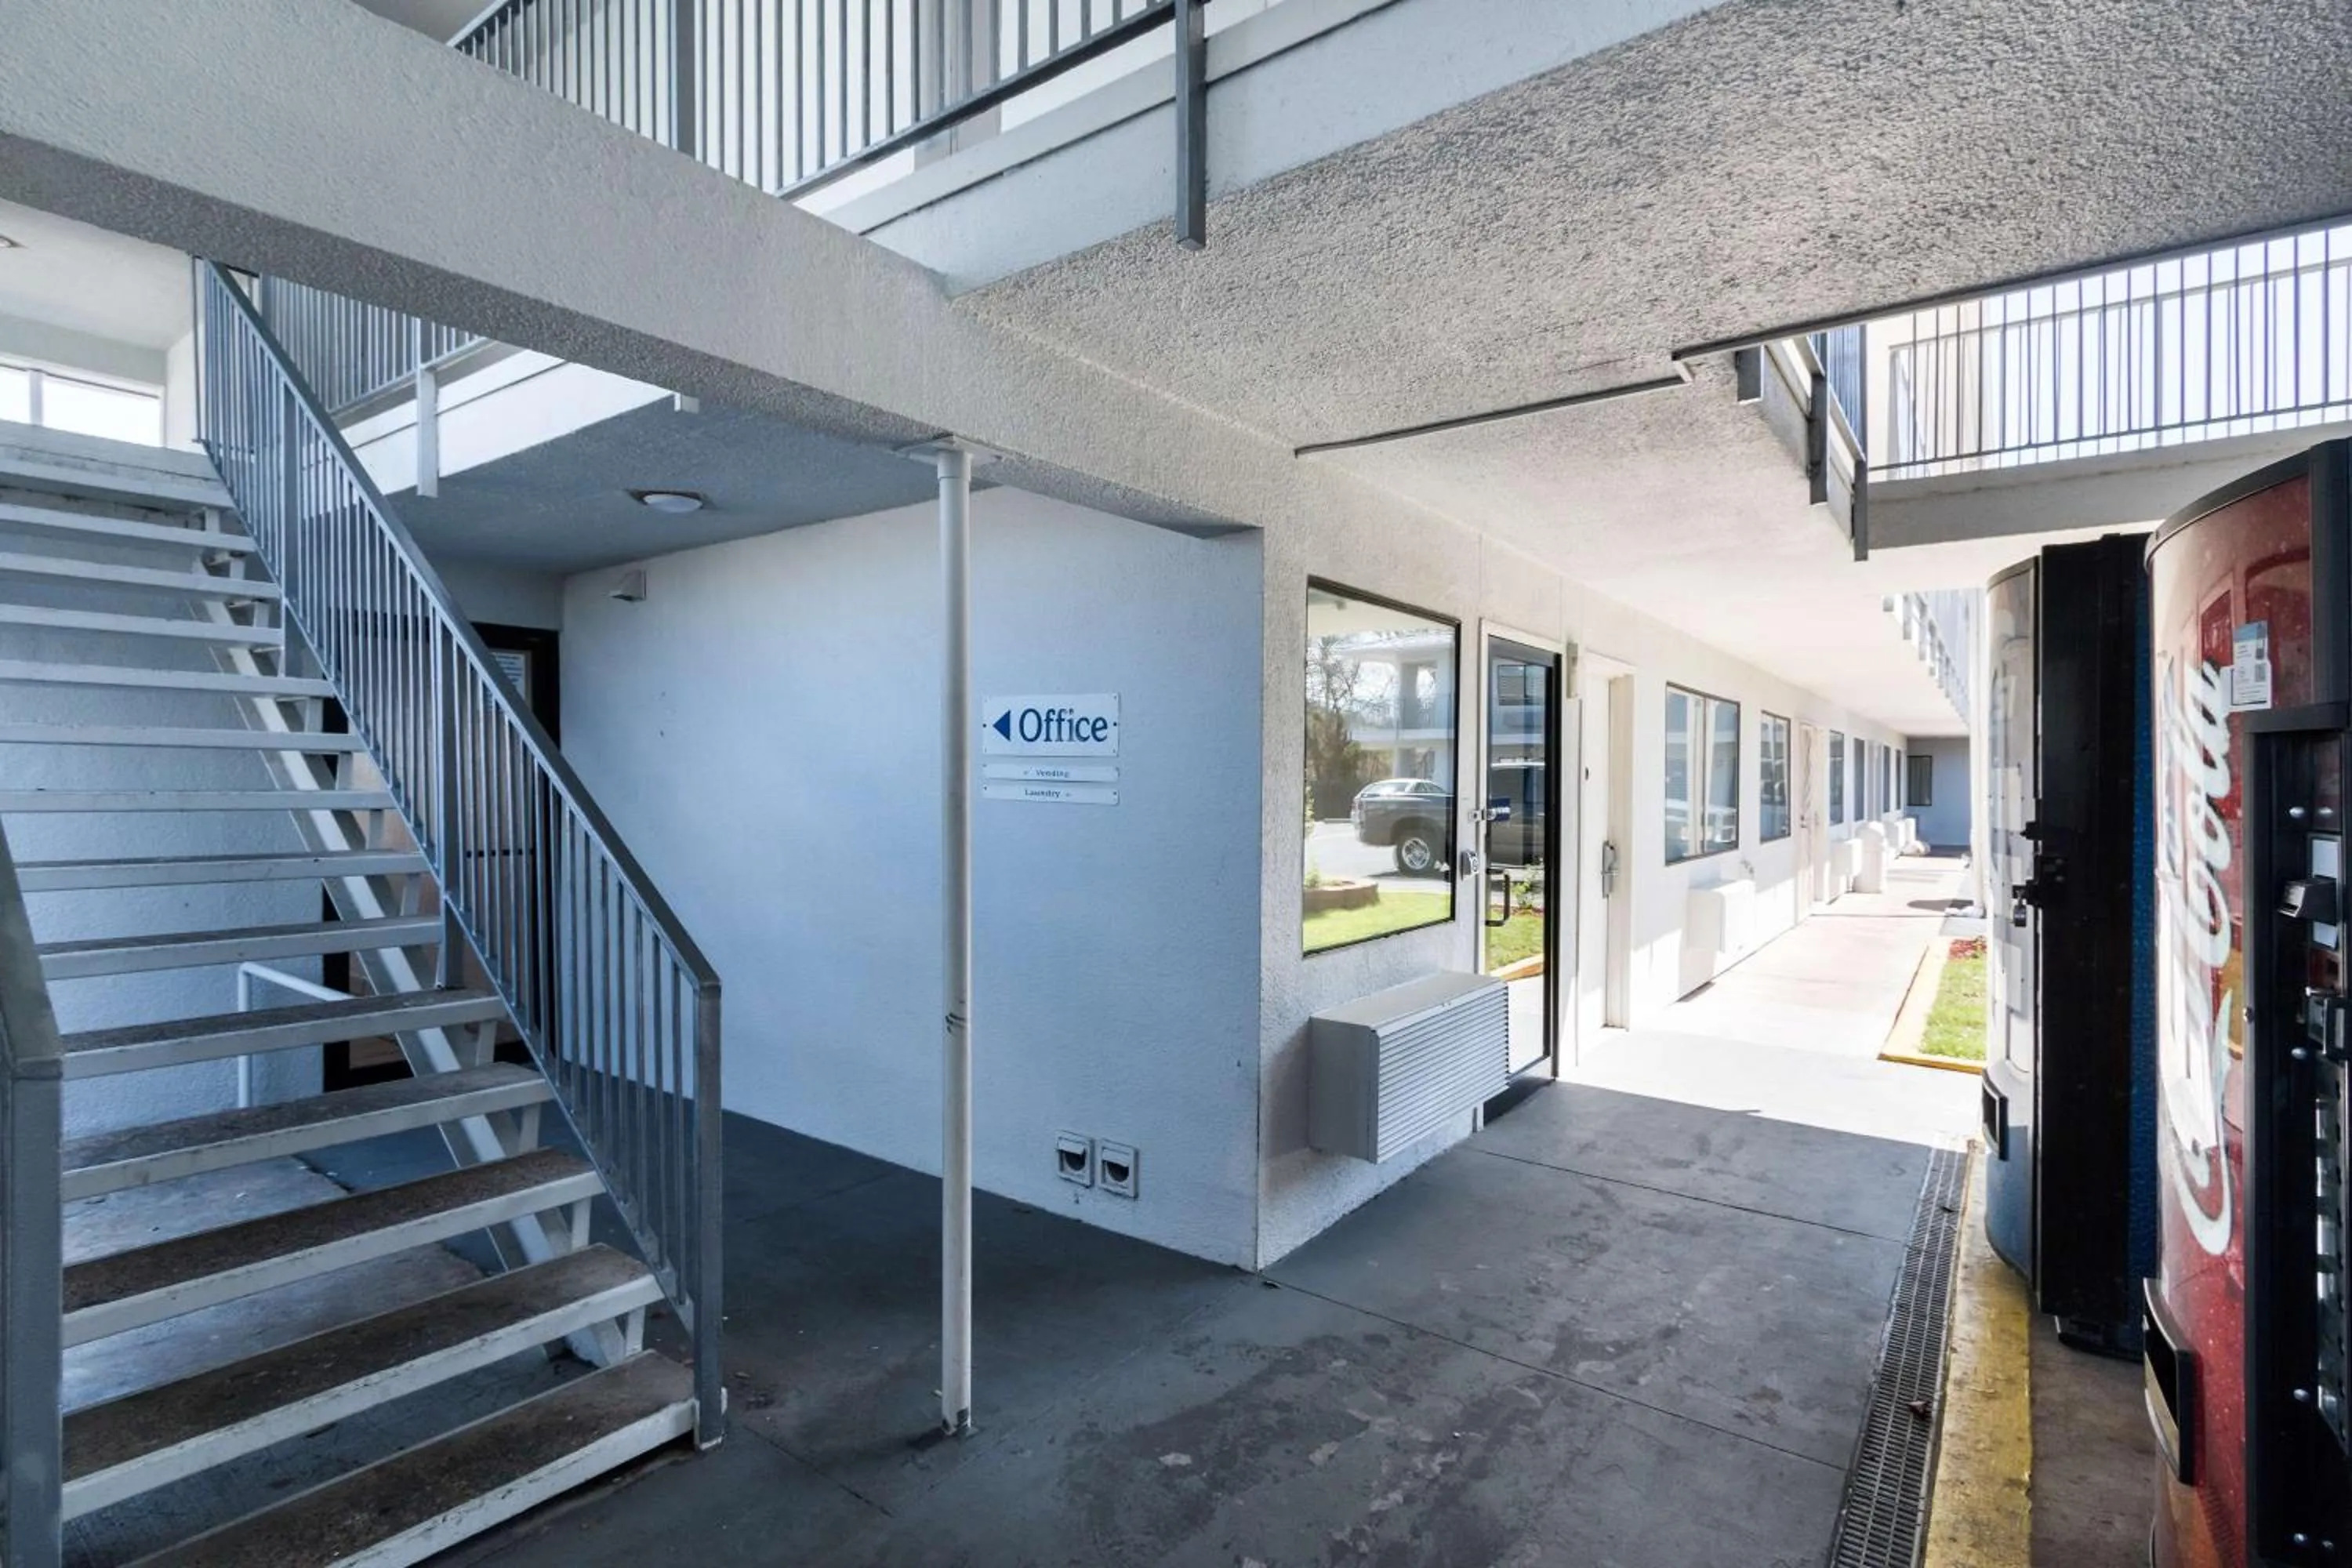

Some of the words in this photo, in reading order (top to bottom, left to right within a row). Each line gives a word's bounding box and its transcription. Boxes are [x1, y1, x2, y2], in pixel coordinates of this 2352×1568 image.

[1018, 708, 1108, 742] Office
[1036, 769, 1069, 779] Vending
[1025, 789, 1061, 798] Laundry
[2158, 657, 2233, 1256] CCola
